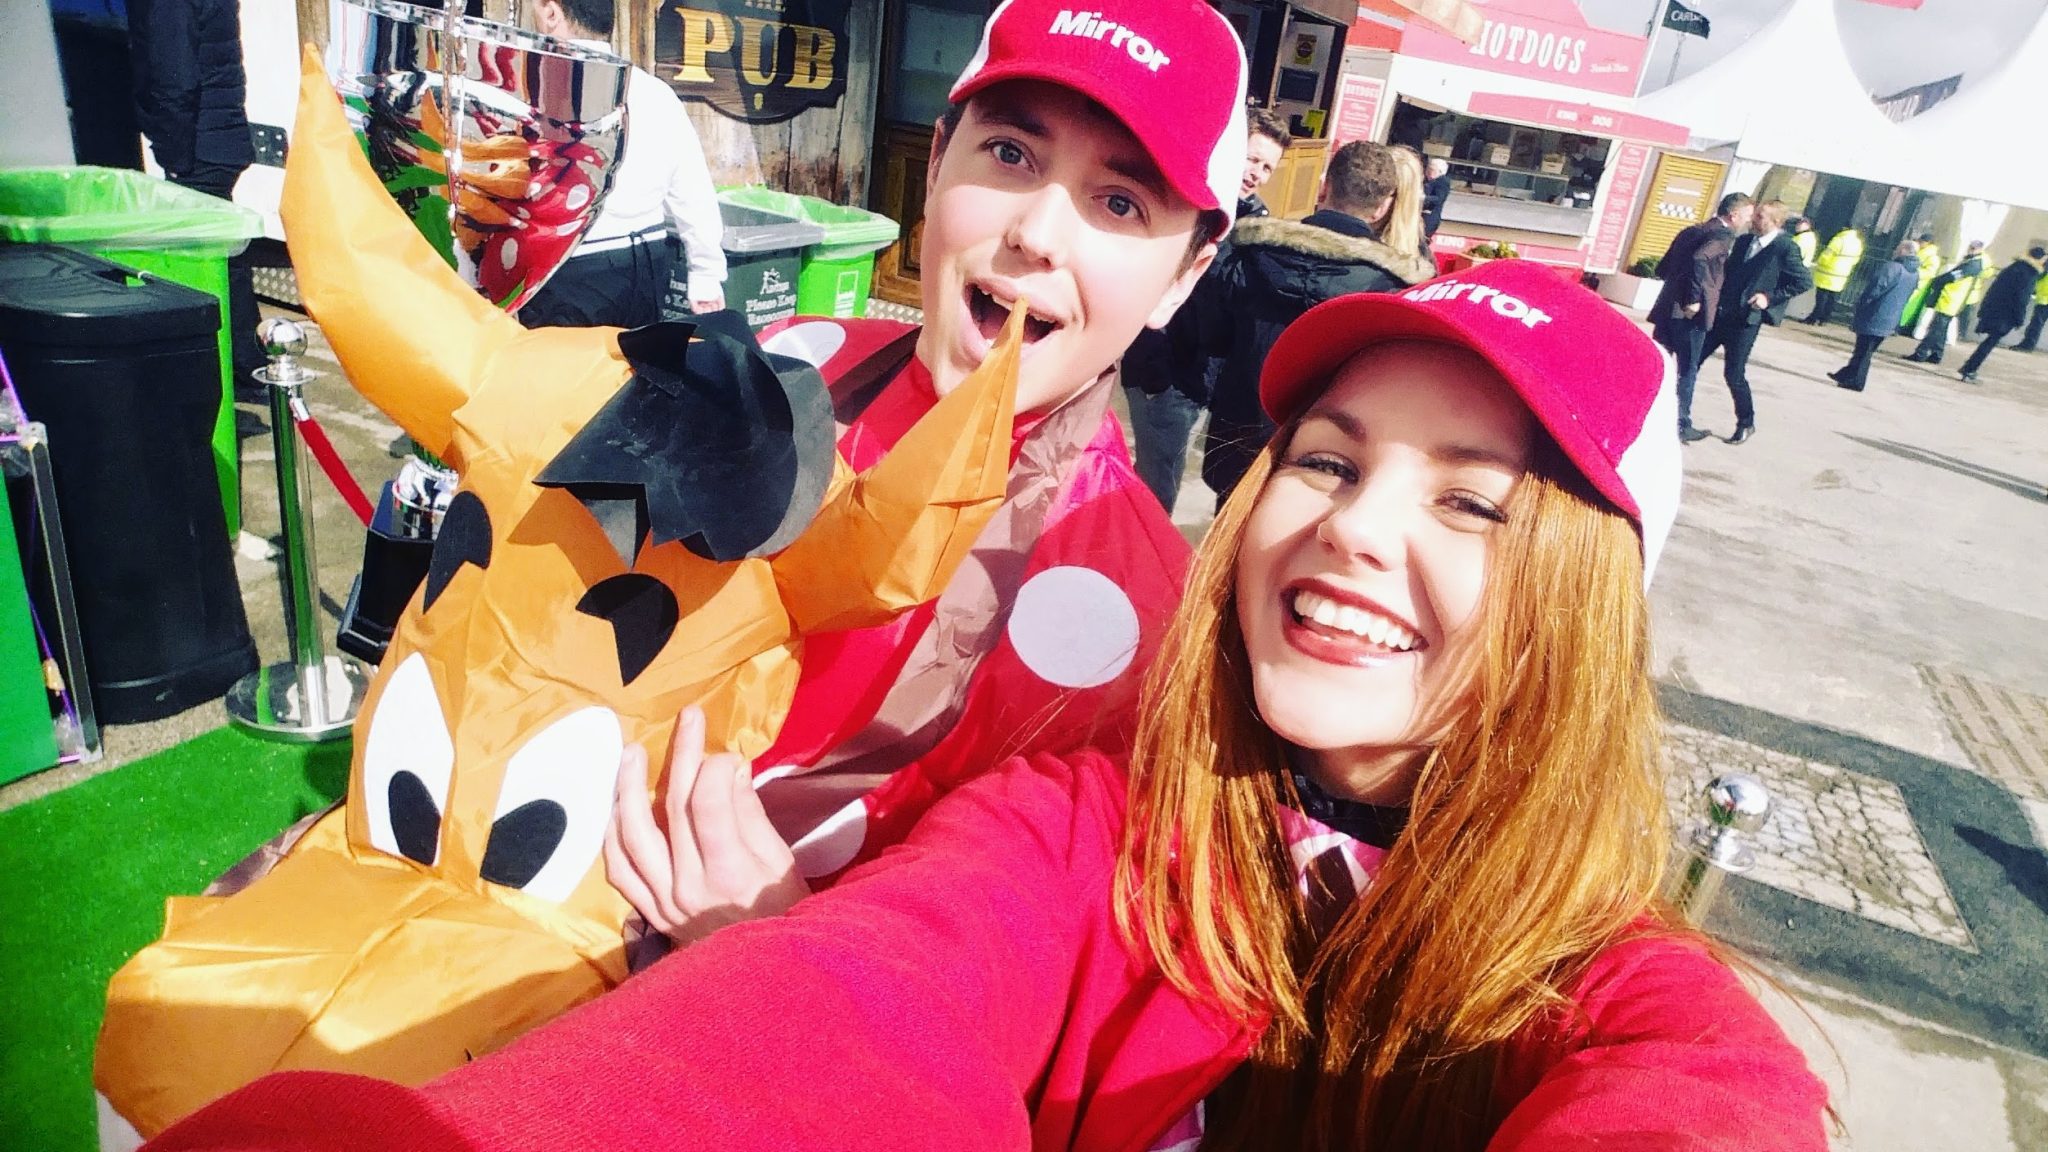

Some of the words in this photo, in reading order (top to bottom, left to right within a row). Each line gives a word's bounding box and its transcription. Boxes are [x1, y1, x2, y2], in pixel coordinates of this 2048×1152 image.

[673, 6, 836, 90] PUB
[1048, 9, 1171, 72] Mirror
[1402, 279, 1553, 328] Mirror
